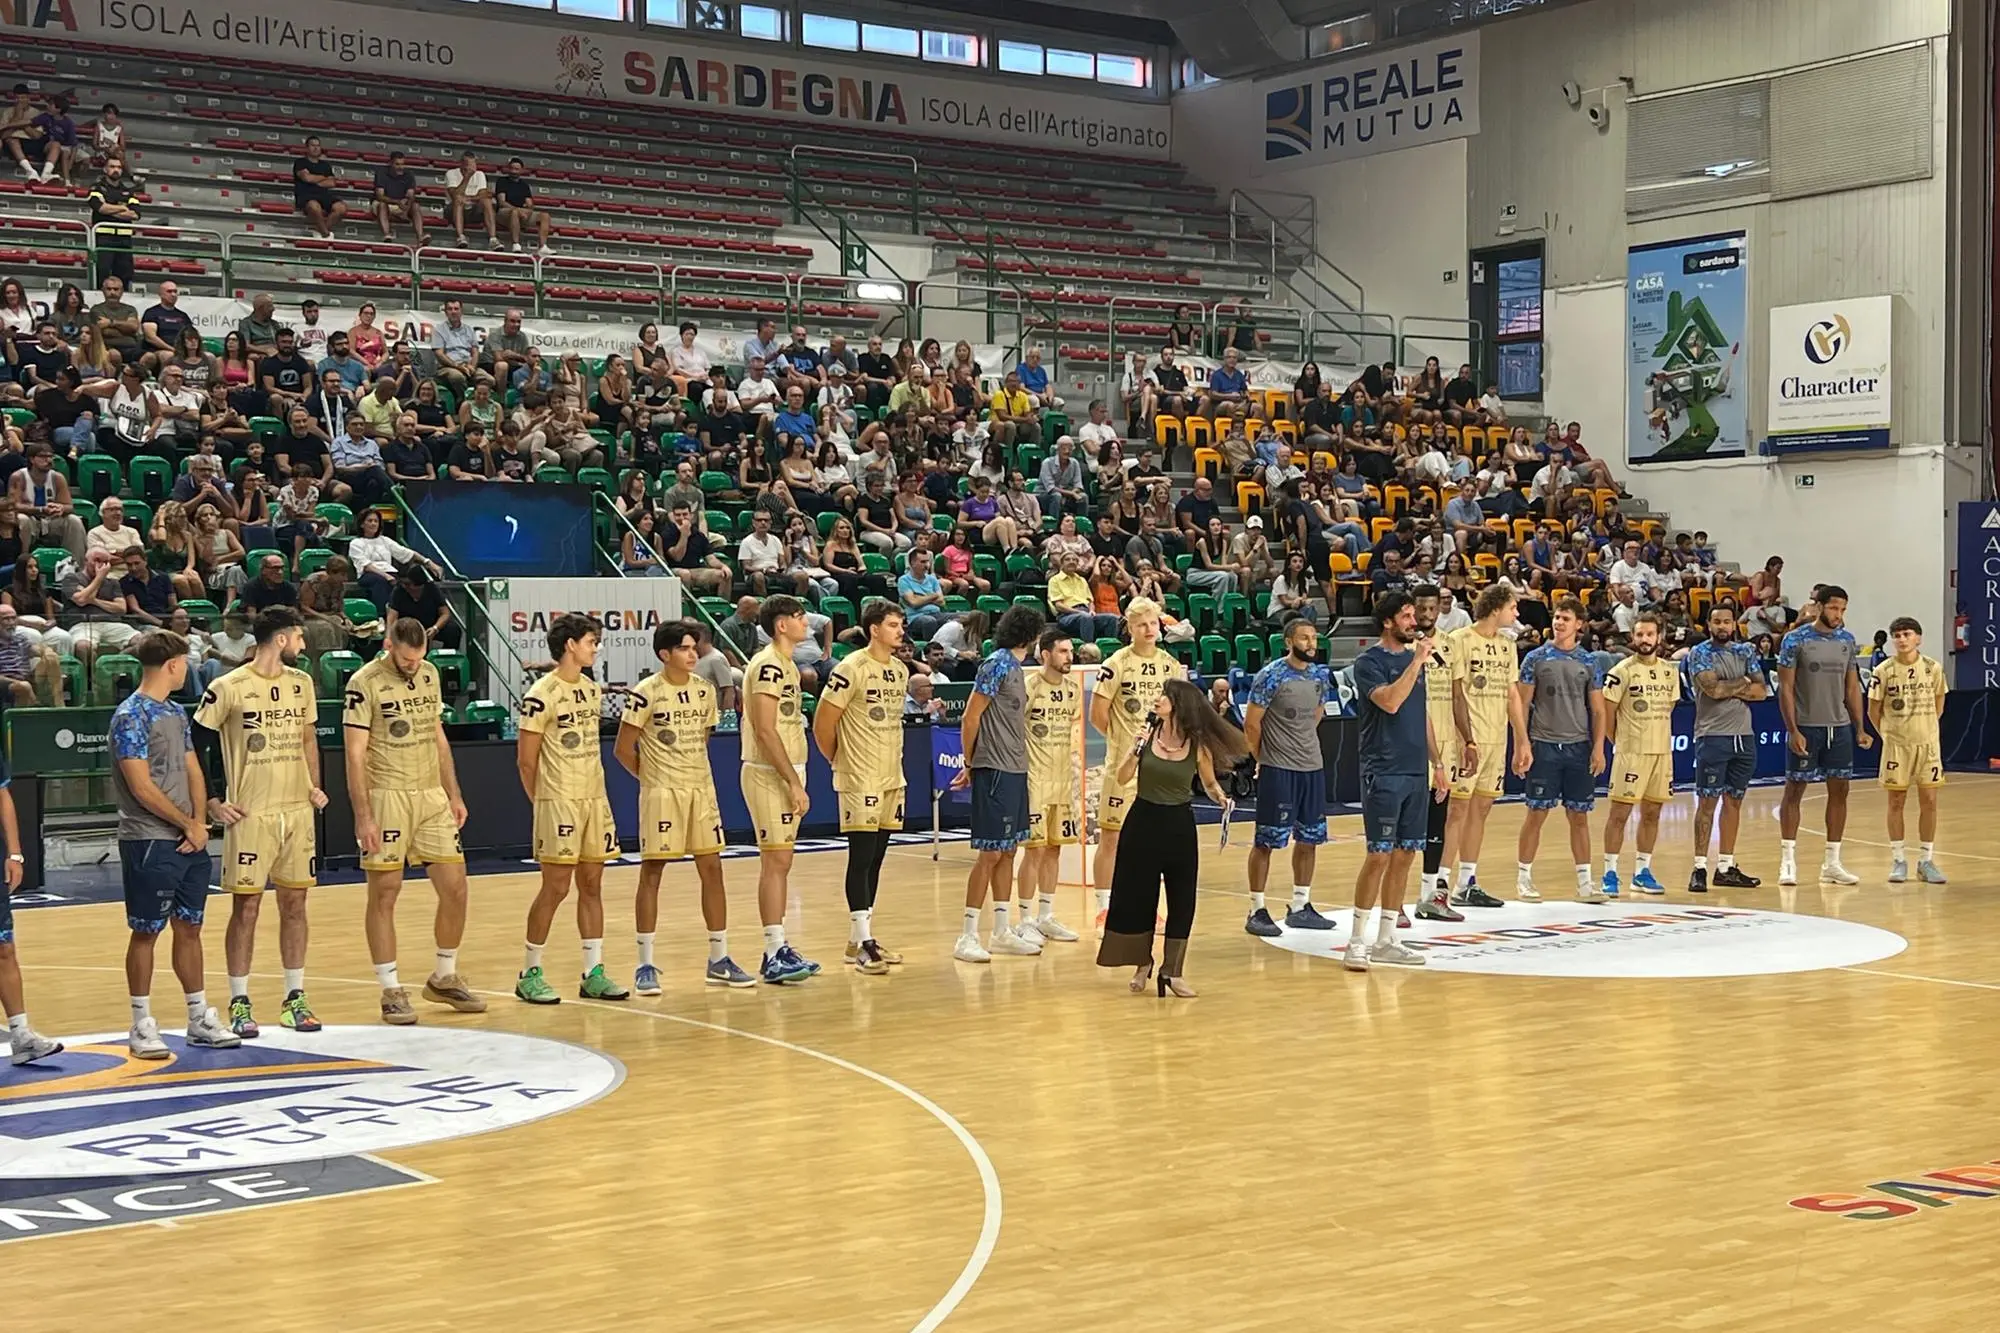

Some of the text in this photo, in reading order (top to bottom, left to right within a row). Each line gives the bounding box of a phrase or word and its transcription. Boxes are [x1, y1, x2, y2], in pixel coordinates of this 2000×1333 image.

[100, 0, 201, 37] ISOLA
[212, 13, 454, 63] dell'Artigianato
[1323, 49, 1464, 117] REALE
[623, 51, 1168, 148] SARDEGNA ISOLA dell'Artigianato
[1323, 97, 1464, 150] MUTUA
[1636, 276, 1664, 290] CASA
[531, 334, 569, 348] ISOLA
[572, 336, 643, 353] dell'Artigia
[1780, 377, 1878, 399] Character
[511, 610, 662, 633] SAGNA
[1485, 643, 1497, 656] 21
[758, 664, 784, 684] EP
[882, 669, 895, 683] 45
[1141, 662, 1156, 676] 25
[1649, 669, 1657, 680] 5
[1907, 668, 1916, 680] 2
[270, 686, 280, 702] 0
[1139, 681, 1162, 690] REA
[677, 691, 690, 704] 11
[265, 719, 302, 728] MUTU
[1931, 766, 1939, 782] 2
[894, 803, 904, 823] 4
[1330, 910, 1757, 951] ARDEGNA
[65, 1075, 523, 1157] REALE
[138, 1086, 579, 1167] MUTUA
